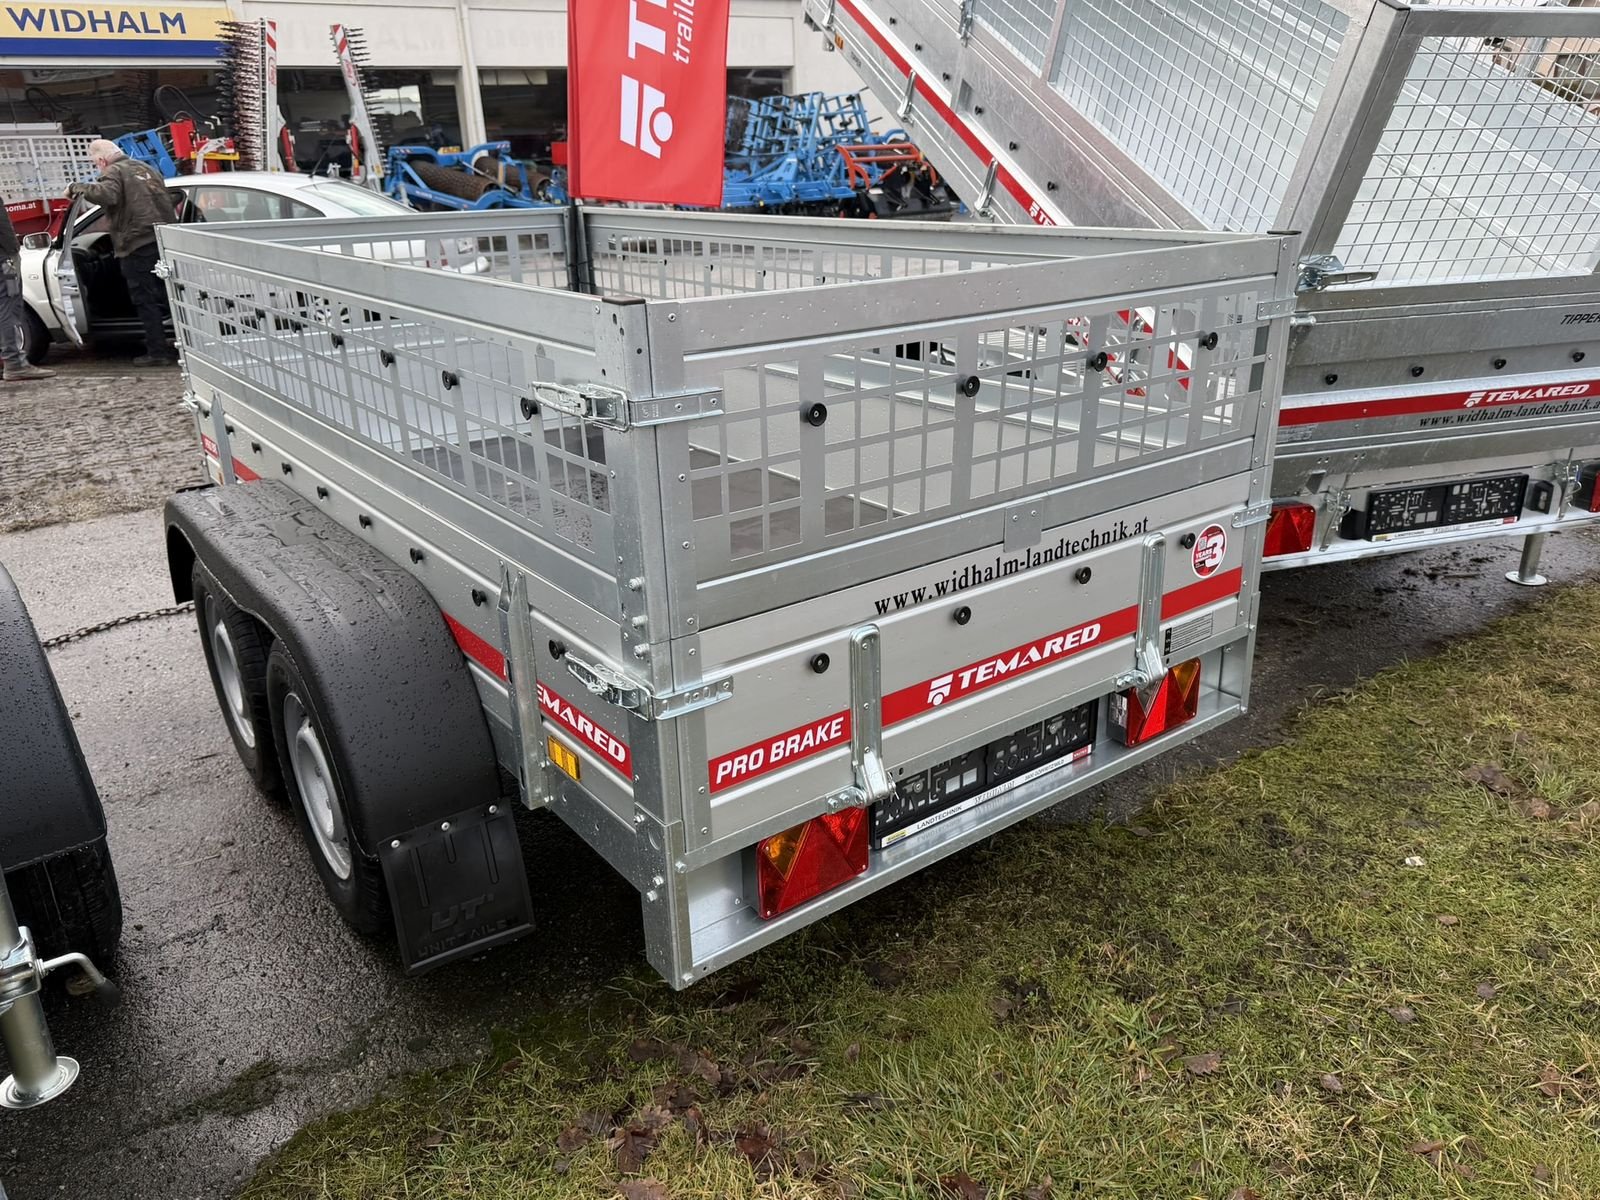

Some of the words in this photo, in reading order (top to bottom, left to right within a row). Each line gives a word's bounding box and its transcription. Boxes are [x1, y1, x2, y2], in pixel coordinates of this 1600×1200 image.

[6, 7, 187, 34] WIDHALM
[1419, 398, 1600, 428] www.widhalm-landtechnik.a
[1486, 384, 1590, 403] TEMARED
[874, 516, 1149, 616] www.widhalm-landtechnik.at
[1206, 534, 1224, 568] 3
[958, 623, 1101, 690] TEMARED
[536, 683, 626, 763] EMARED
[716, 748, 765, 784] PRO
[769, 716, 844, 763] BRAKE
